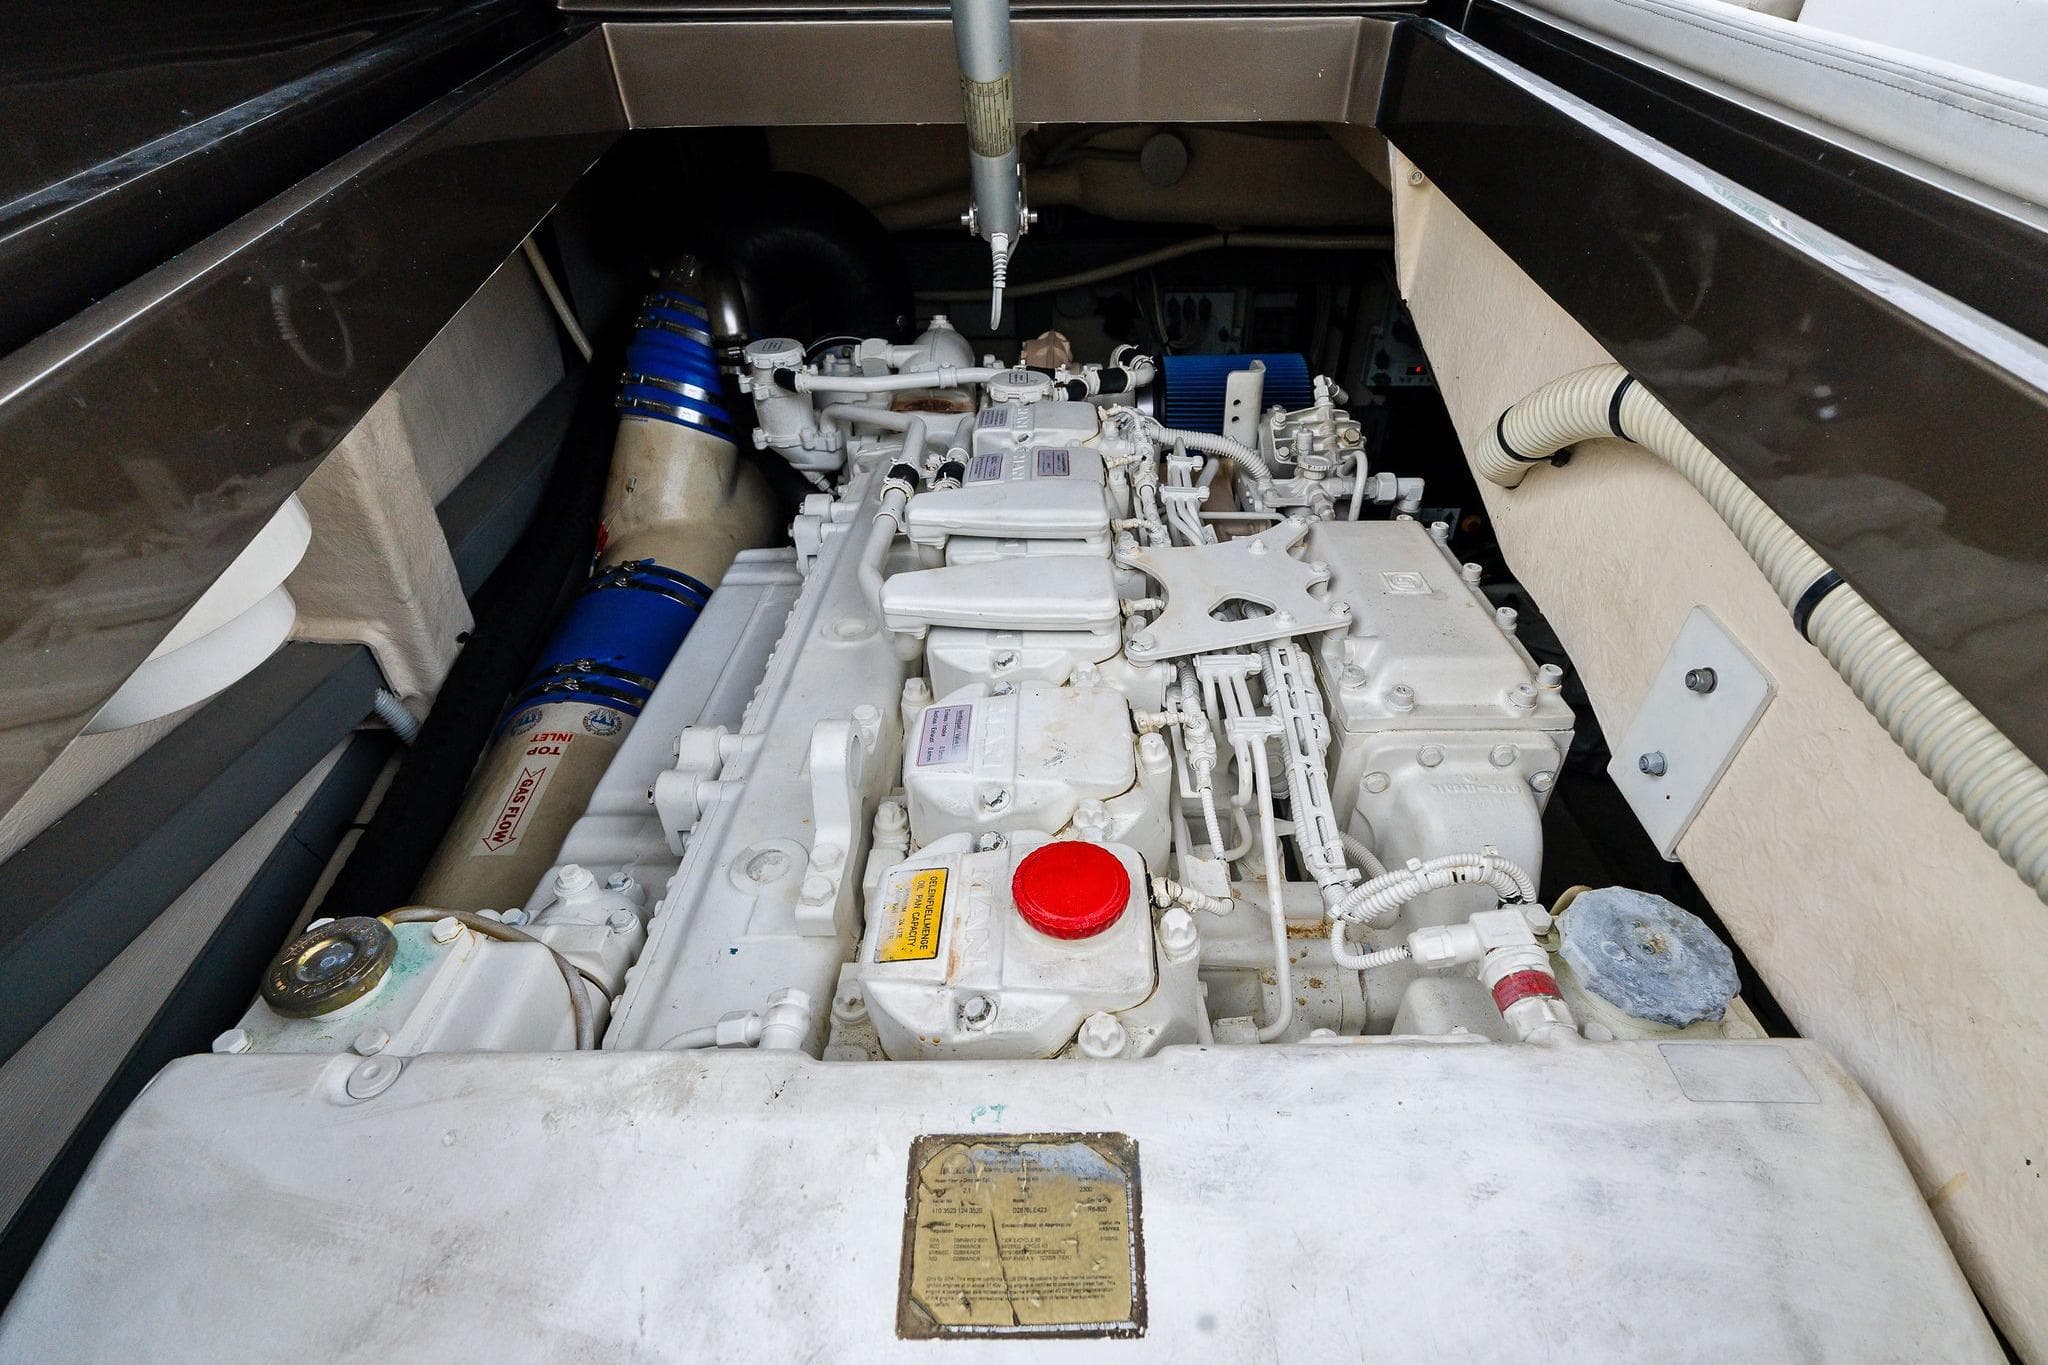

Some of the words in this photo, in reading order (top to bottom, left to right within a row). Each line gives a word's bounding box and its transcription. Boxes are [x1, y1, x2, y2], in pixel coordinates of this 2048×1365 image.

[529, 732, 573, 743] INLET
[526, 746, 561, 755] TOP
[512, 778, 534, 804] GAS
[492, 806, 520, 843] FLOW
[916, 880, 925, 892] OIL
[913, 894, 923, 909] PAN
[919, 876, 938, 950] OELEINFUELLMENGE
[907, 912, 920, 947] CAPACITY
